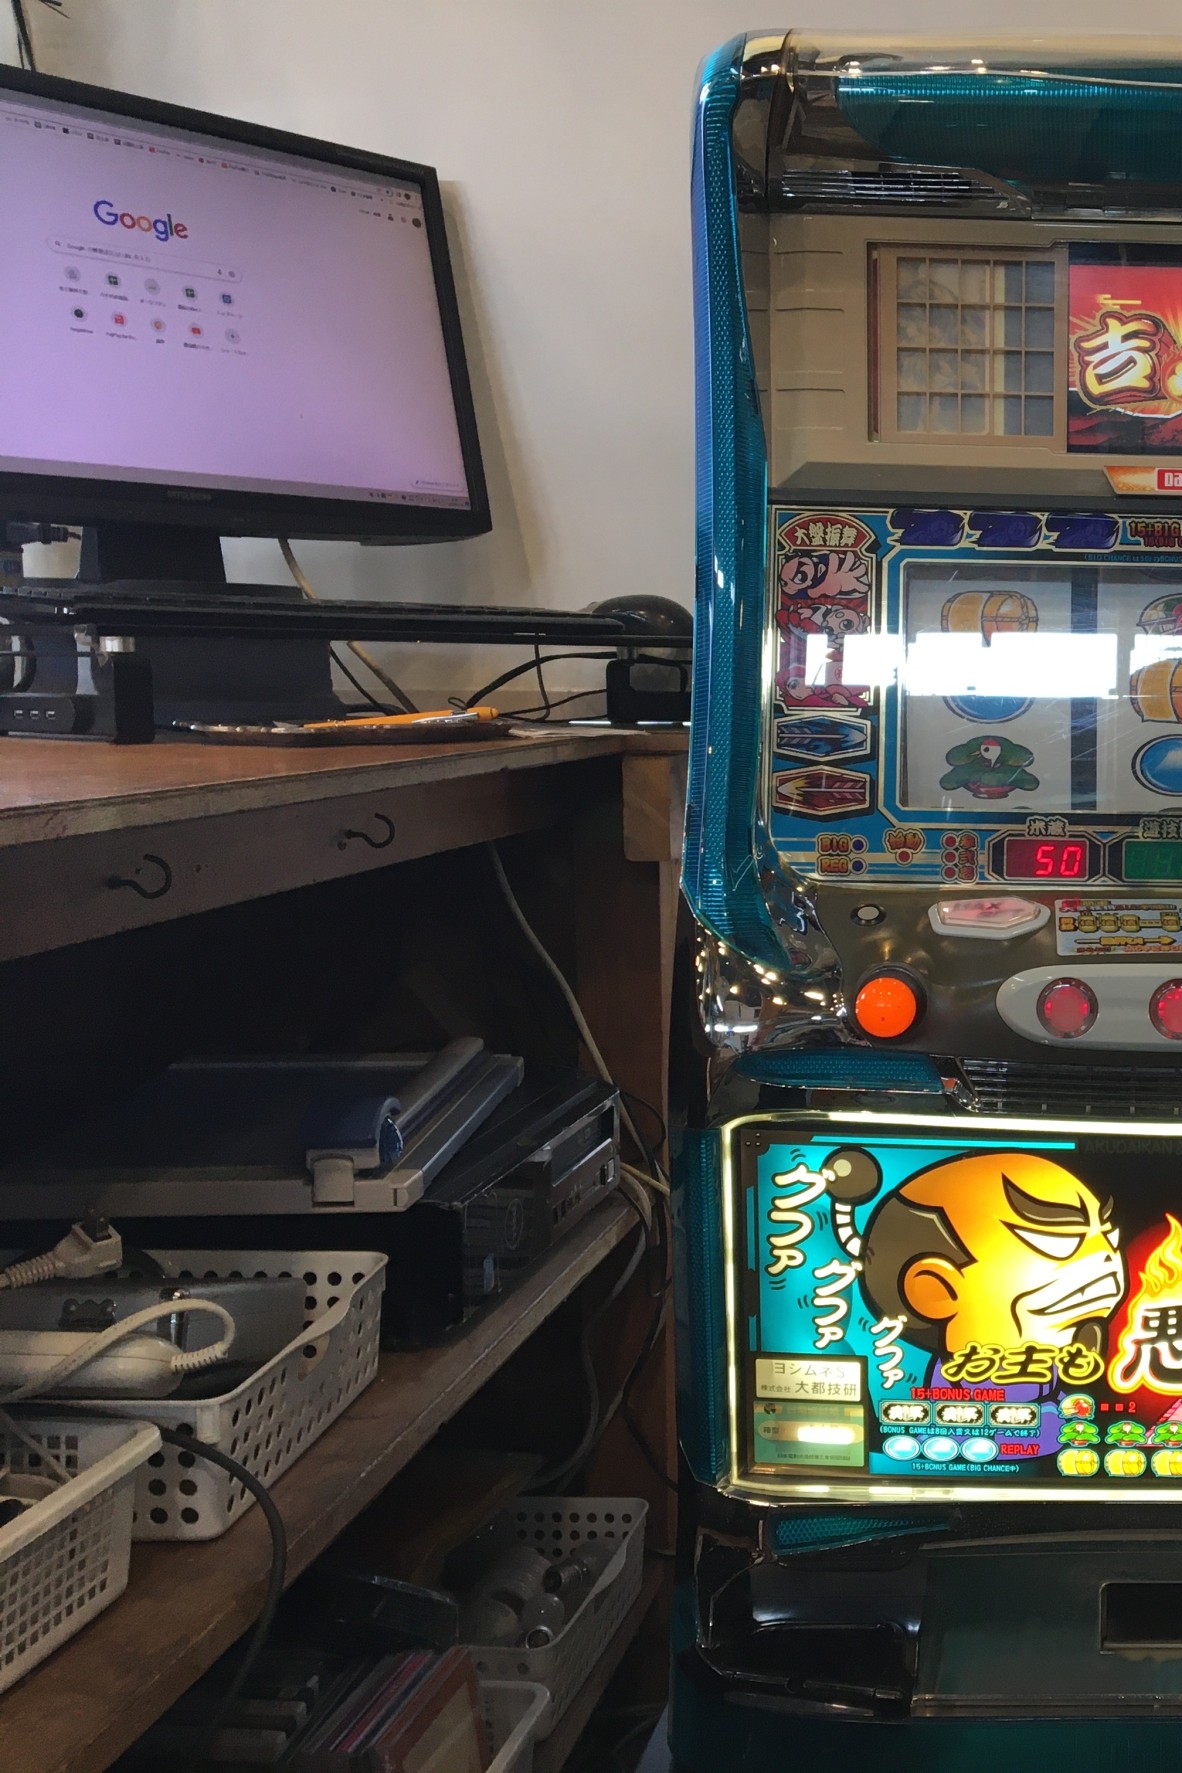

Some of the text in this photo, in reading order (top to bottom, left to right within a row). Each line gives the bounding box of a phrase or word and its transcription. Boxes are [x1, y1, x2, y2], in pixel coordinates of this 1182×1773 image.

[94, 200, 188, 242] Google
[794, 521, 858, 547] 大盤振舞
[821, 837, 849, 853] BIG
[821, 859, 848, 874] REG
[1035, 846, 1082, 877] 50
[942, 1342, 1104, 1386] お主も
[761, 1380, 857, 1397] 株式会社 大都技研
[911, 1388, 1006, 1402] 15+BONUS GAME
[879, 1426, 906, 1435] (BONUS
[1000, 1444, 1040, 1455] REPLAY
[912, 1462, 947, 1472] 15+BONUS
